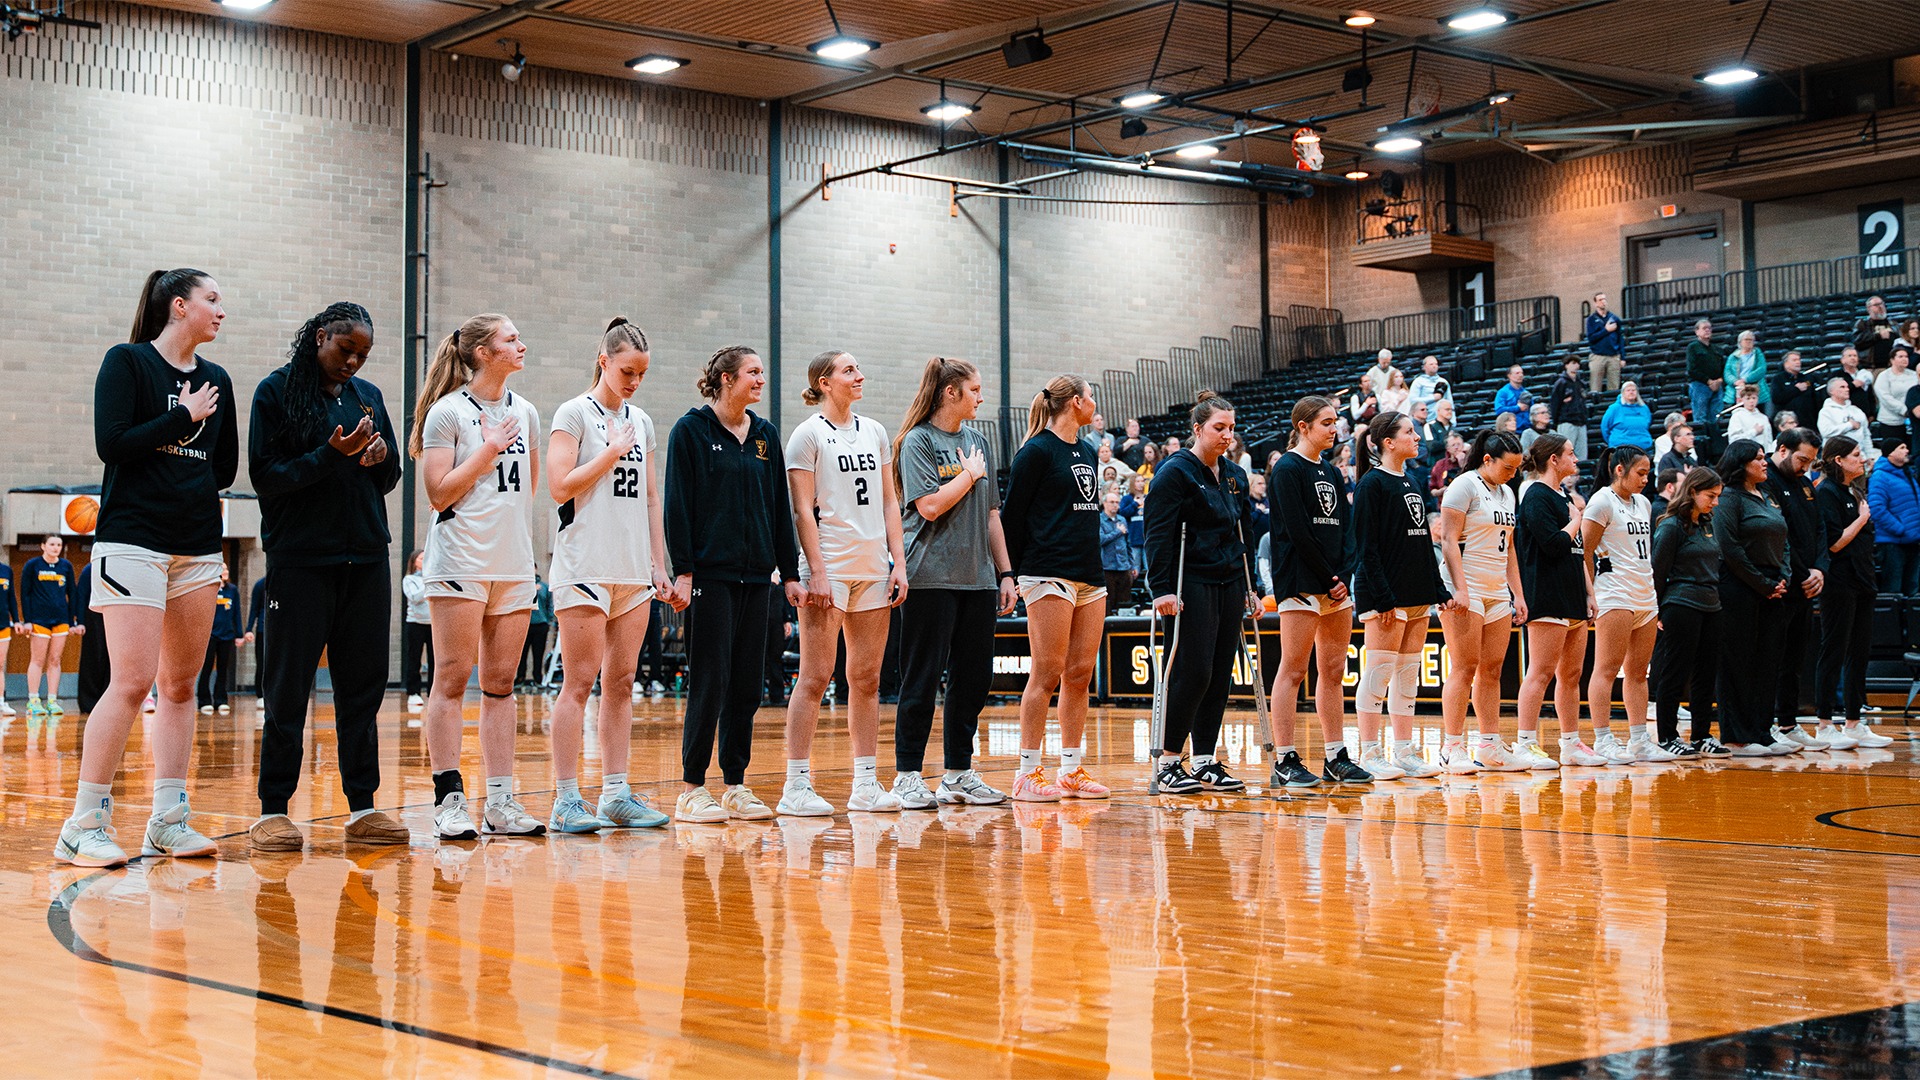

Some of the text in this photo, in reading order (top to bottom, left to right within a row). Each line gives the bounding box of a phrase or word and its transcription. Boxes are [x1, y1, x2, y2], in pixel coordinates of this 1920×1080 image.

[1863, 210, 1899, 269] 2
[1465, 272, 1484, 321] 1
[156, 445, 207, 460] ASKETBALL
[838, 453, 876, 472] OLES
[496, 461, 520, 492] 14
[613, 467, 638, 498] 22
[855, 477, 869, 505] 2
[1493, 511, 1515, 527] OLES
[1627, 521, 1649, 535] OLES
[1498, 530, 1506, 552] 3
[1636, 539, 1648, 559] 11
